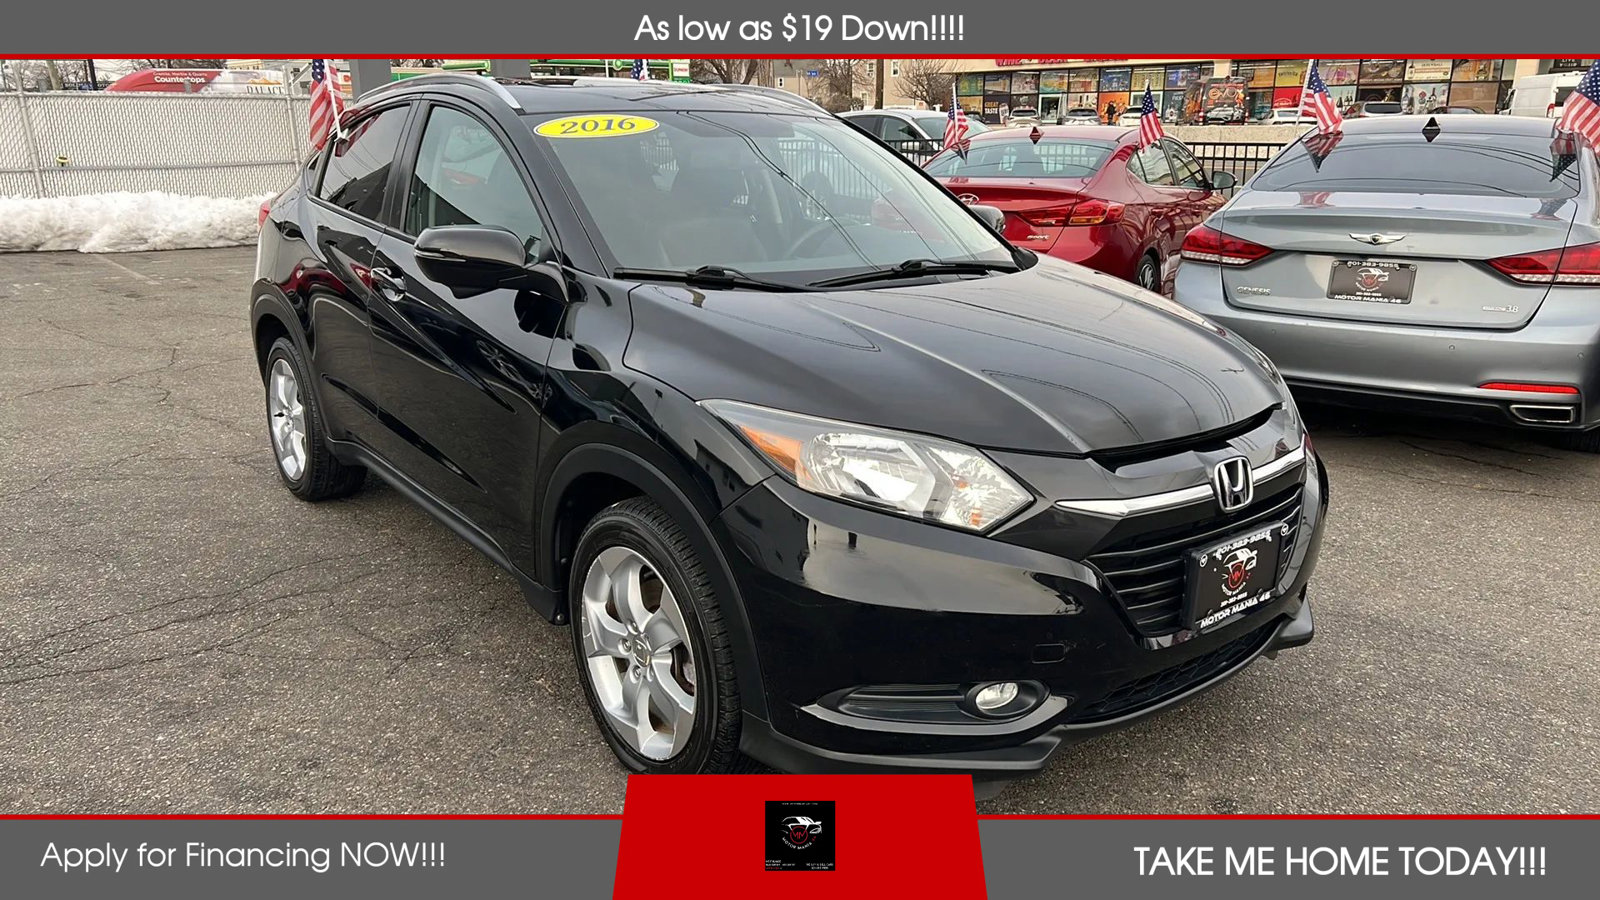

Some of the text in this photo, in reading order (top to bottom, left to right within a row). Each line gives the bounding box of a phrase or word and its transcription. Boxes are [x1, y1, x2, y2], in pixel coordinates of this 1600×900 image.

[560, 118, 636, 135] 2016
[1200, 591, 1271, 629] MOTOR MANIA 46
